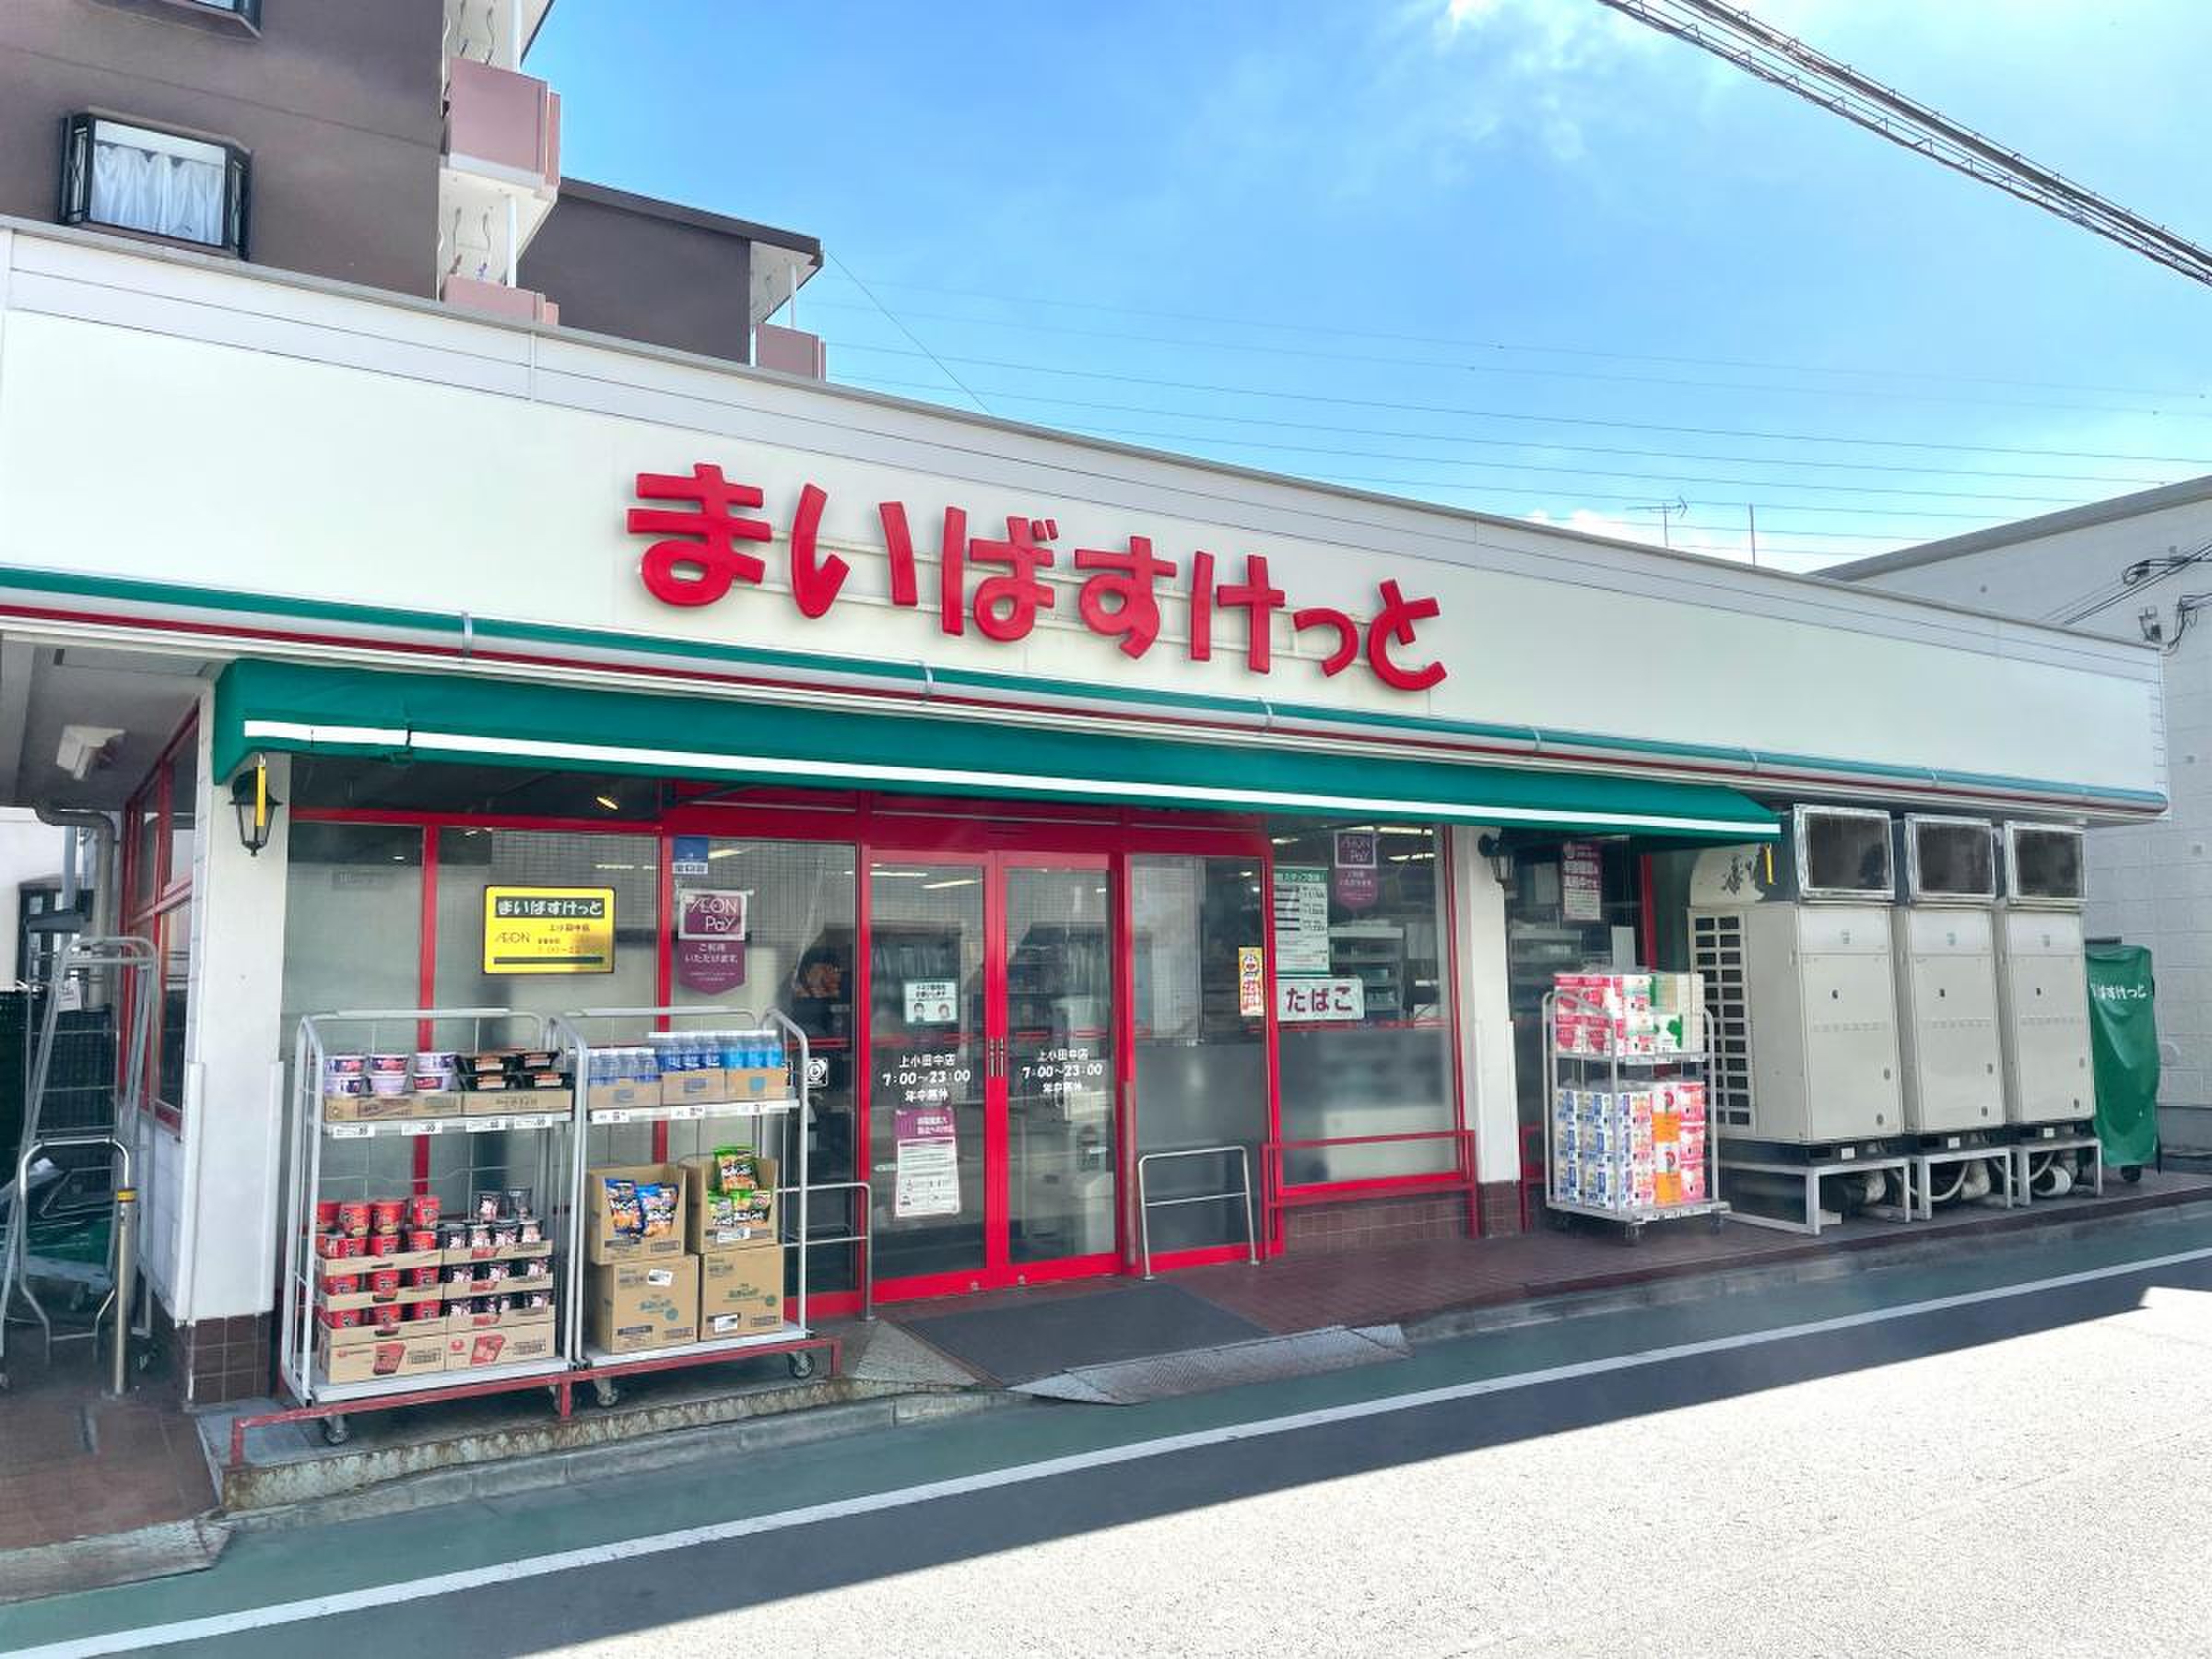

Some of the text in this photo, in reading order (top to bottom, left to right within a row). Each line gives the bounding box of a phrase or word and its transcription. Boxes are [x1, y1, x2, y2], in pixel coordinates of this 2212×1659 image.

[627, 463, 1446, 691] まいばすけっと
[498, 900, 603, 915] まいばすけっと
[689, 898, 737, 914] AEON
[705, 915, 736, 933] Pay
[495, 932, 531, 945] AEON
[1287, 986, 1352, 1012] たばこ
[899, 1053, 956, 1068] 上小田中店
